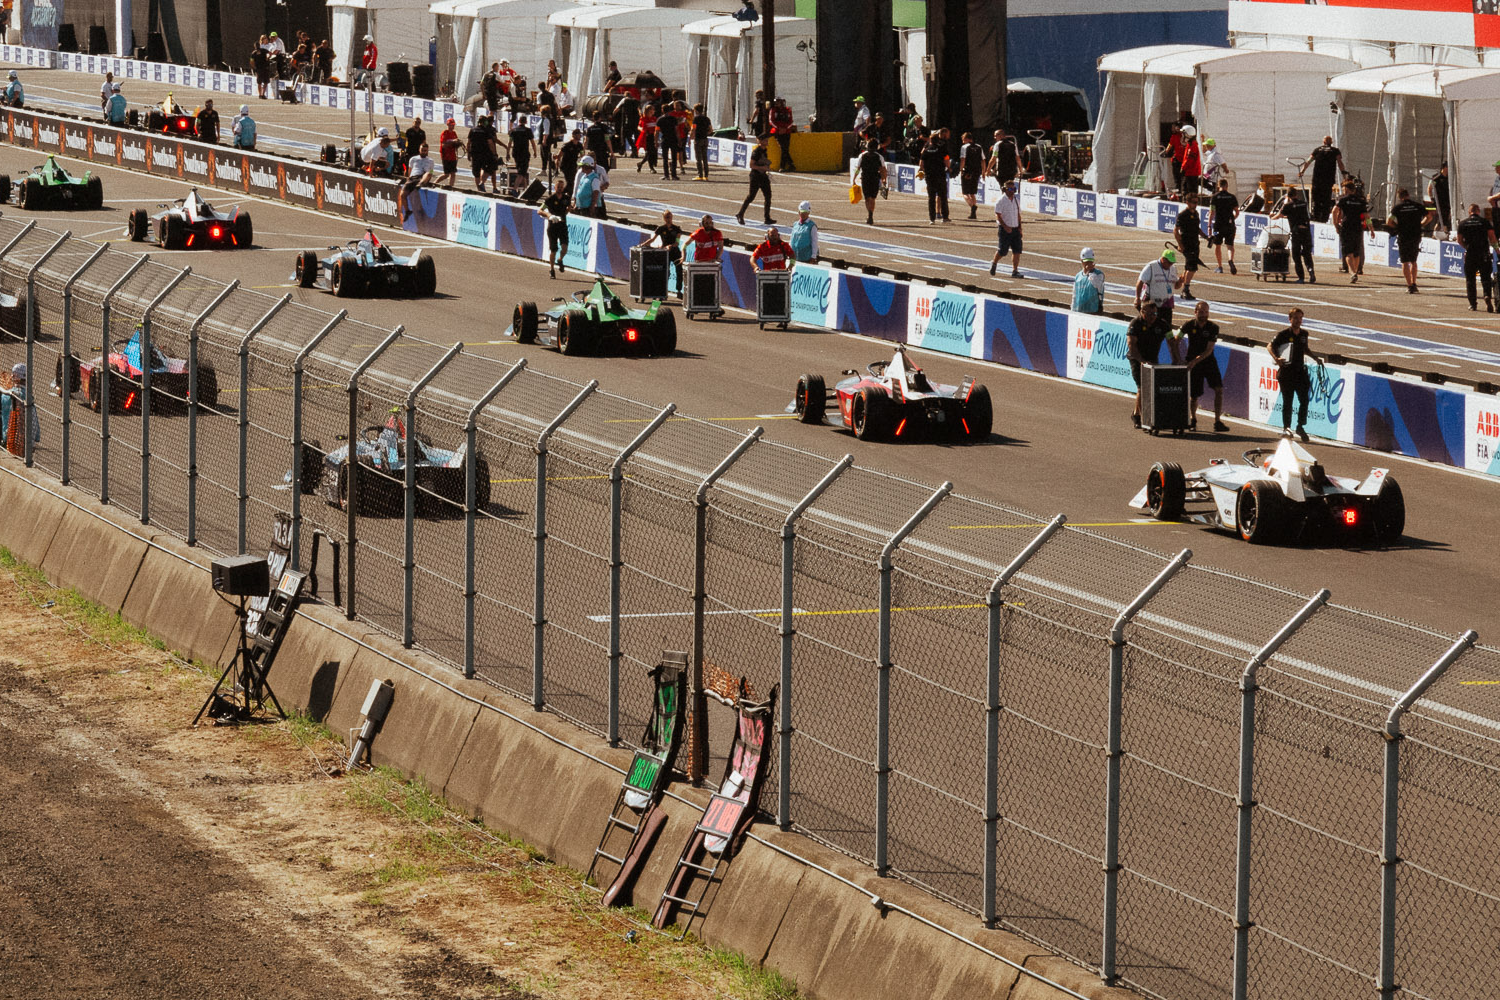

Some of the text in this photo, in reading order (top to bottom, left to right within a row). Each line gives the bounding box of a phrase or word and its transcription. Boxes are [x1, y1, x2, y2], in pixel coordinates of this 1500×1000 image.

[215, 156, 242, 183] Southwire
[249, 163, 277, 190] Southwire
[286, 171, 315, 200] Southwire
[324, 179, 354, 208] Southwire
[364, 187, 398, 218] Southwire
[916, 296, 930, 318] ABB
[931, 297, 967, 328] FORMULA
[1076, 328, 1092, 350] ABB
[1086, 362, 1100, 373] WORLD
[1100, 365, 1131, 377] CHAMPIONSHIP
[1259, 366, 1279, 392] ABB
[1477, 410, 1499, 437] ABB
